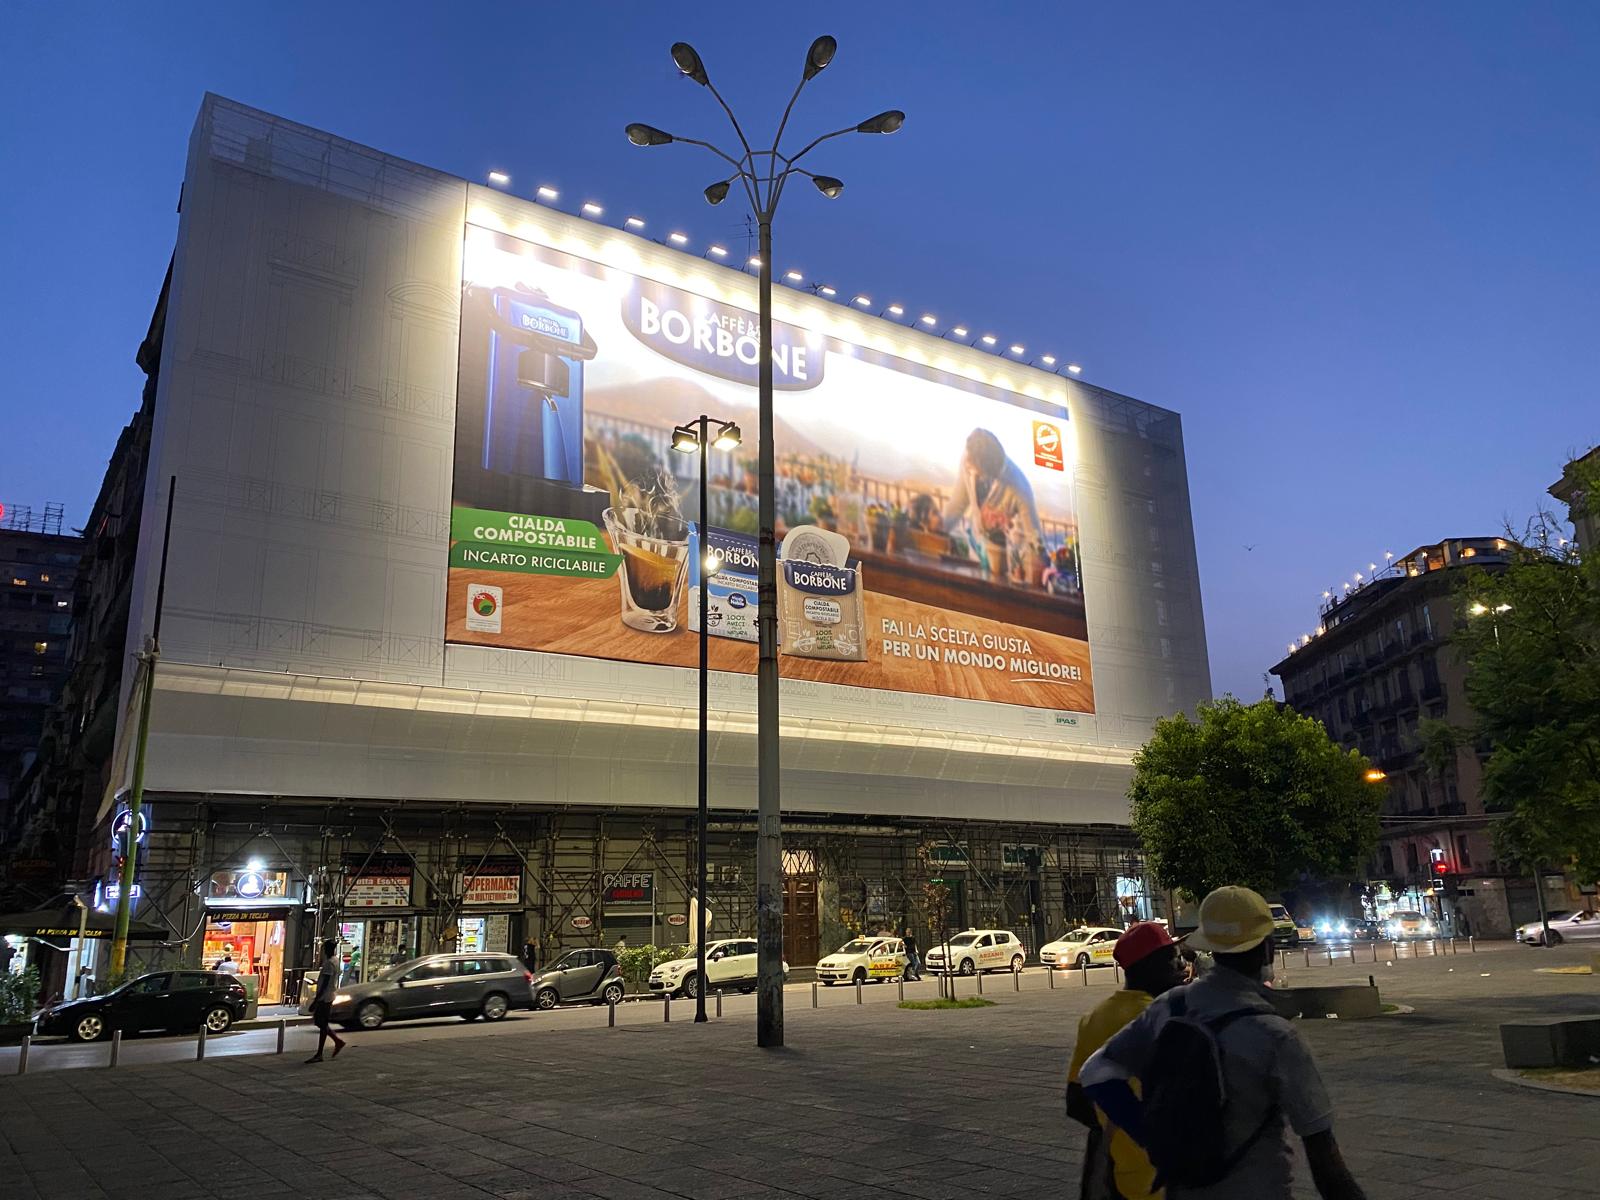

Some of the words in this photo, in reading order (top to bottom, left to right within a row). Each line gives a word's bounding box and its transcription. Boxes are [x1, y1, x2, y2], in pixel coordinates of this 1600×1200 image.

[641, 296, 807, 381] BORBONE
[508, 516, 566, 533] CIALDA
[473, 526, 597, 549] COMPOSTABILE
[463, 549, 527, 566] INCARTO
[531, 556, 606, 573] RICICLABILE
[707, 544, 759, 568] BORBON
[729, 576, 759, 587] COMPOSTAB
[793, 571, 847, 591] BORBONE
[881, 618, 903, 636] FAI
[908, 622, 927, 640] LA
[930, 626, 980, 647] SCELTA
[983, 633, 1033, 655] GIUSTA
[882, 639, 912, 658] PER
[915, 644, 940, 662] UN
[944, 648, 1006, 671] MONDO
[1010, 657, 1082, 681] MIGLIORE!
